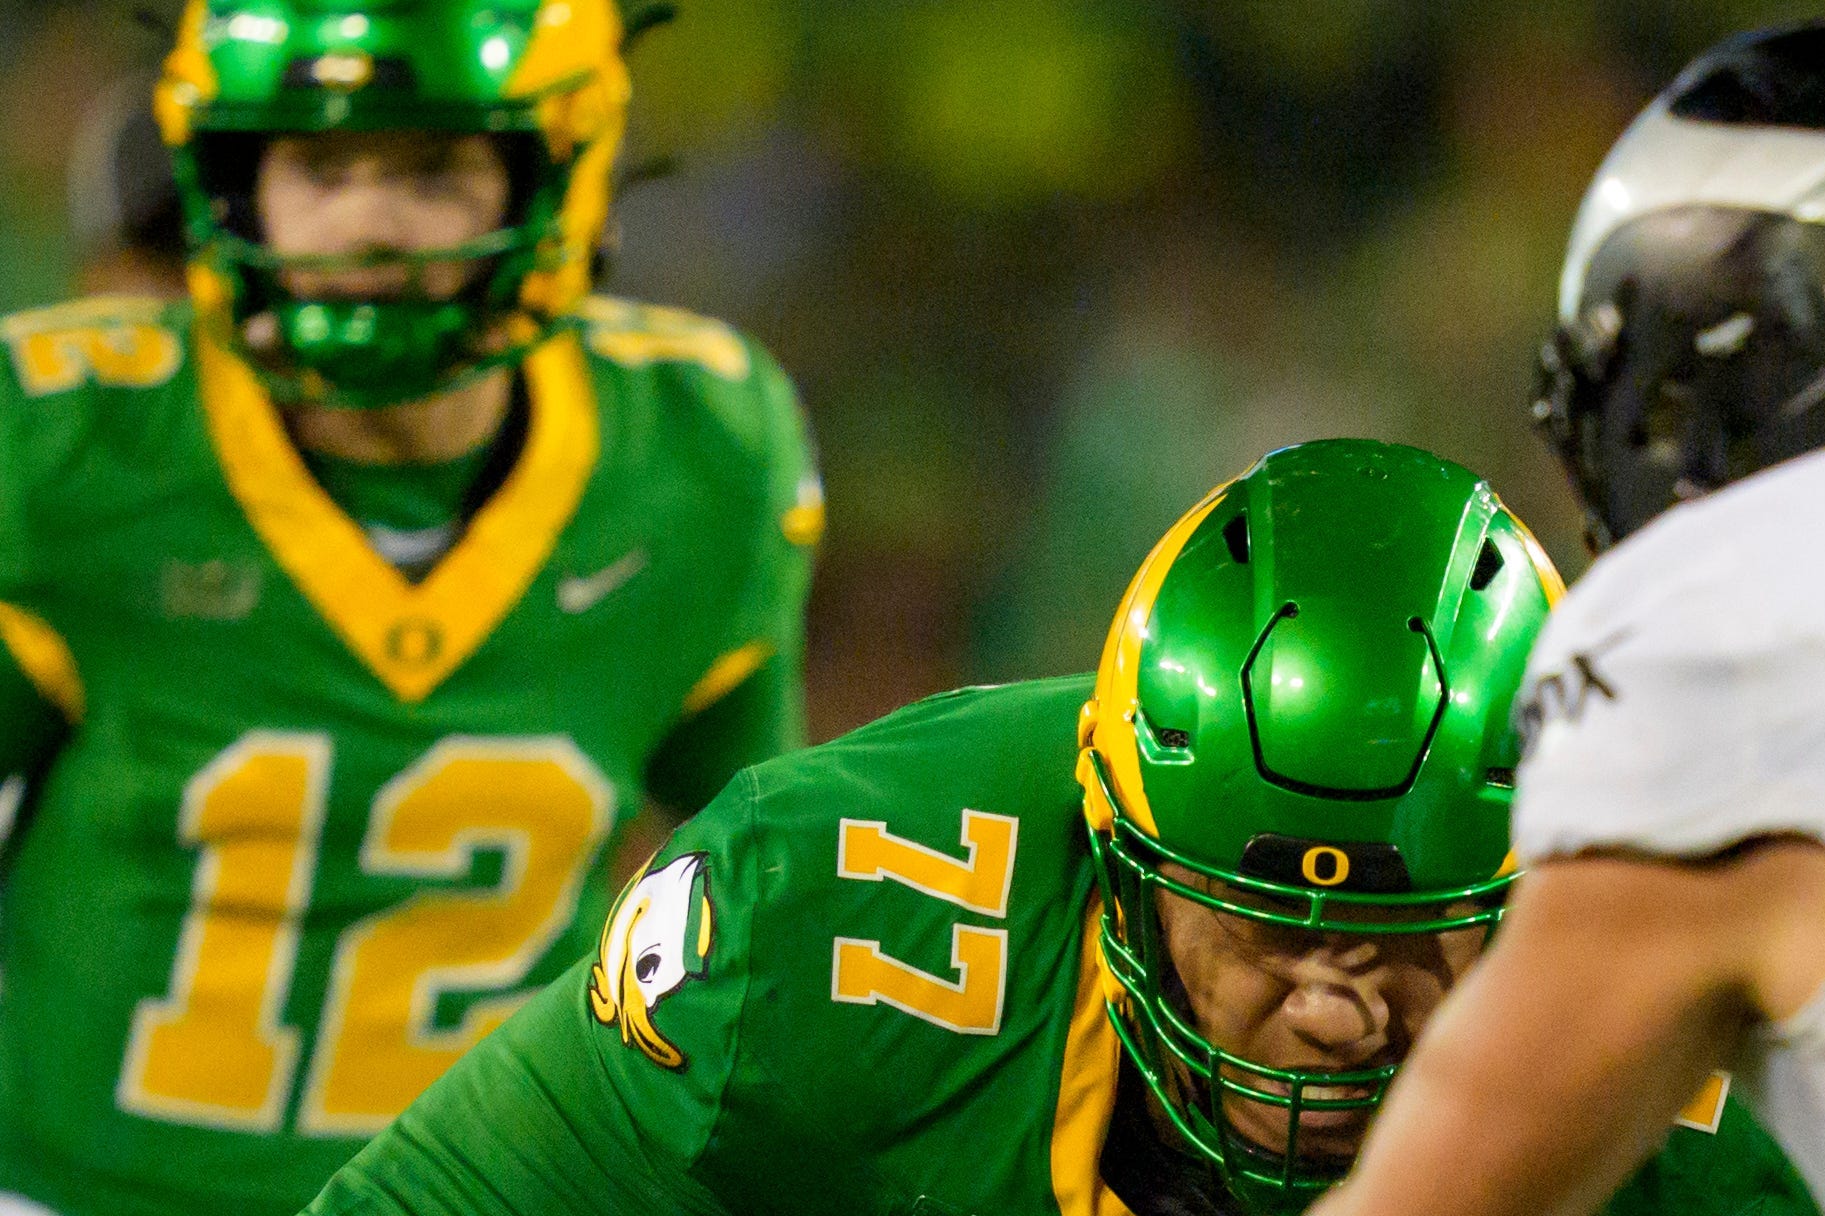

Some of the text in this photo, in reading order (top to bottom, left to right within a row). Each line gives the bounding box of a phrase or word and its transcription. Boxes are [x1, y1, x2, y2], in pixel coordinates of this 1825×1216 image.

[116, 729, 616, 1137] 12
[831, 808, 1019, 1036] 77
[1302, 845, 1349, 886] O
